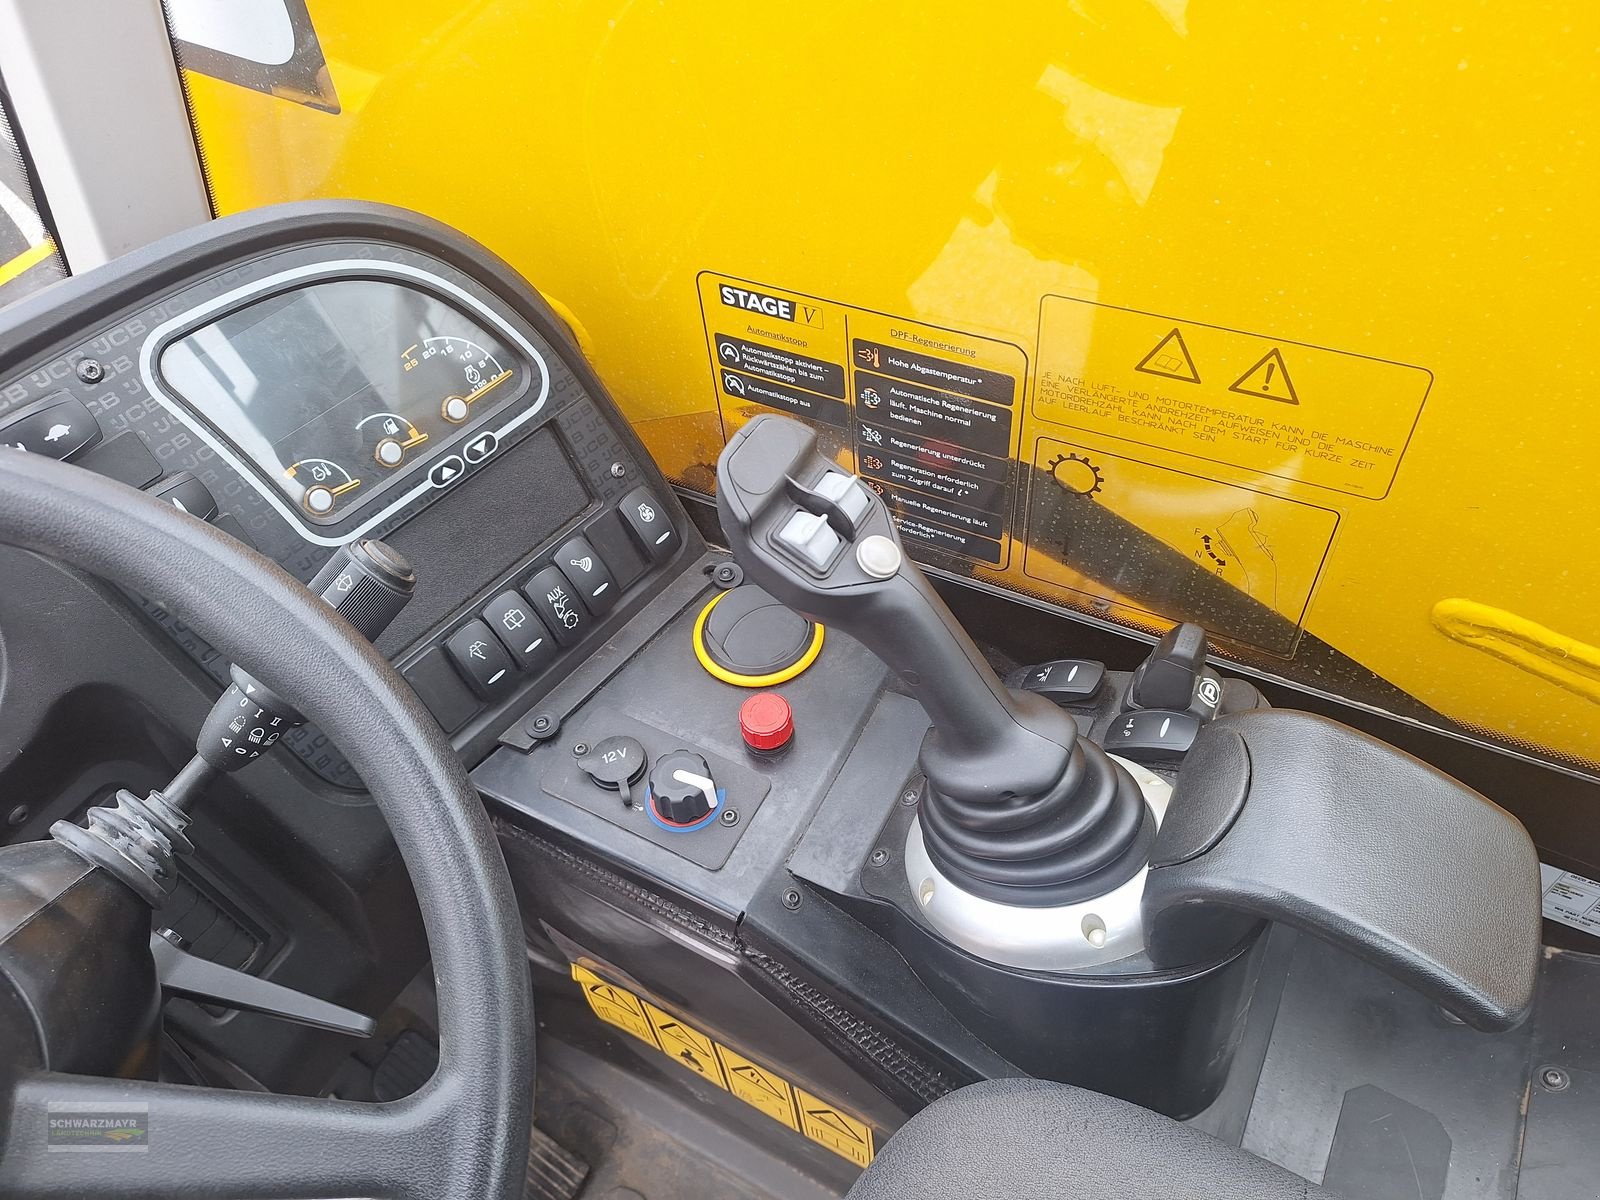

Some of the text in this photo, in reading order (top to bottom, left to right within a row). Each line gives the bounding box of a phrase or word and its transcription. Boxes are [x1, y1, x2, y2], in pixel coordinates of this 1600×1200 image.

[721, 286, 817, 324] STAGE V
[91, 319, 147, 355] JCB
[746, 325, 808, 348] Automatikstopp
[890, 328, 976, 358] DPF-Regenerierung
[403, 358, 419, 372] 25
[422, 344, 487, 369] 20 15 10 5
[741, 345, 794, 365] Automatikstopp
[795, 359, 823, 373] aktiviert
[742, 353, 825, 382] Rückwärtszählen bis zum
[888, 357, 909, 369] Hohe
[743, 363, 796, 383] Automatikstopp
[747, 384, 811, 408] Automatikstopp aus
[889, 387, 997, 422] Automatische Regenerierung
[889, 412, 922, 426] bedienen
[909, 404, 943, 419] Maschine
[944, 412, 971, 426] normal
[1038, 396, 1057, 405] AUF
[1062, 401, 1112, 417] LEERLAUF
[1192, 431, 1216, 442] SEIN
[1041, 379, 1060, 390] EINE
[1145, 403, 1210, 423] ANDREHZEIT
[1217, 419, 1281, 440] AUFWEISEN
[1287, 434, 1311, 447] UND
[1317, 442, 1335, 452] DIE
[1042, 371, 1396, 457] JE NACH LUFT- UND MOTORTEMPERATUR KANN DIE MASCHINE
[1040, 387, 1376, 471] MOTORDREHZAHL KANN NACH DEM START FÜR KURZE ZEIT
[890, 437, 986, 470] Regenerierung unterdrückt
[890, 459, 979, 490] Regeneration erforderlich
[891, 471, 954, 494] zum Zugriff darauf
[891, 493, 988, 528] Manuelle Regenerierung läuft
[892, 515, 966, 544] Service-Regenerierung
[896, 524, 935, 539] rforderlich
[1194, 527, 1201, 536] F
[1194, 549, 1203, 559] N
[1215, 567, 1223, 576] R
[546, 585, 565, 603] AUX
[602, 747, 627, 764] 12 V
